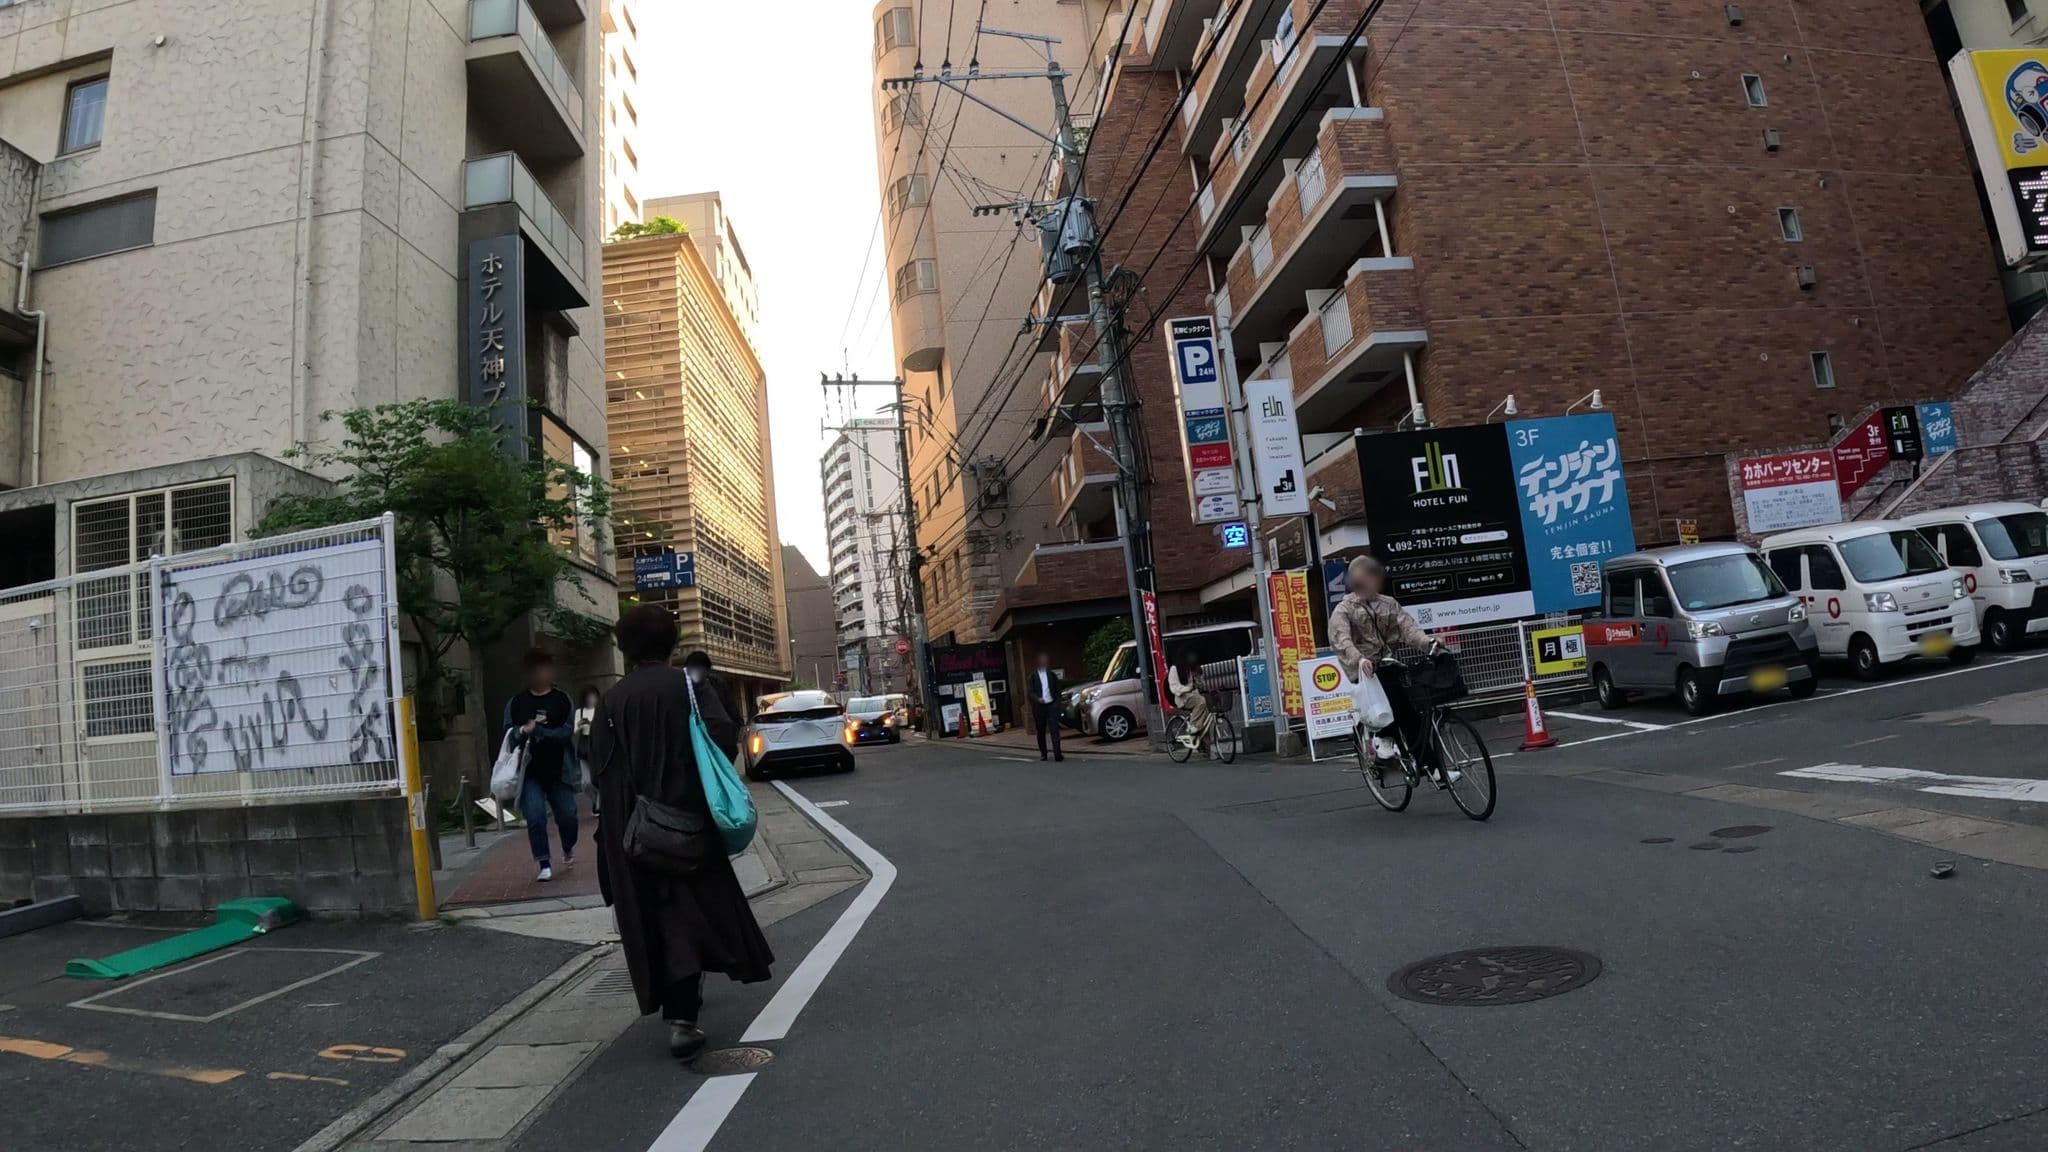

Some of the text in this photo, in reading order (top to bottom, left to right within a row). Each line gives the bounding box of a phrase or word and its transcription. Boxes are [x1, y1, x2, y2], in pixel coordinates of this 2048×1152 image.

[1183, 345, 1211, 377] P
[1198, 367, 1215, 377] 24H
[1515, 429, 1540, 447] 3F
[1866, 424, 1880, 438] 3F
[1743, 456, 1830, 480] カホパーツセンター
[1413, 495, 1468, 508] HOTEL FUN
[1529, 469, 1621, 525] サウナ
[1583, 505, 1615, 522] SAUNA
[1224, 525, 1247, 548] 空
[676, 553, 689, 570] P
[1437, 603, 1500, 618] www.hotelfun.jp
[1251, 663, 1266, 675] 3F
[1316, 671, 1337, 684] STOP
